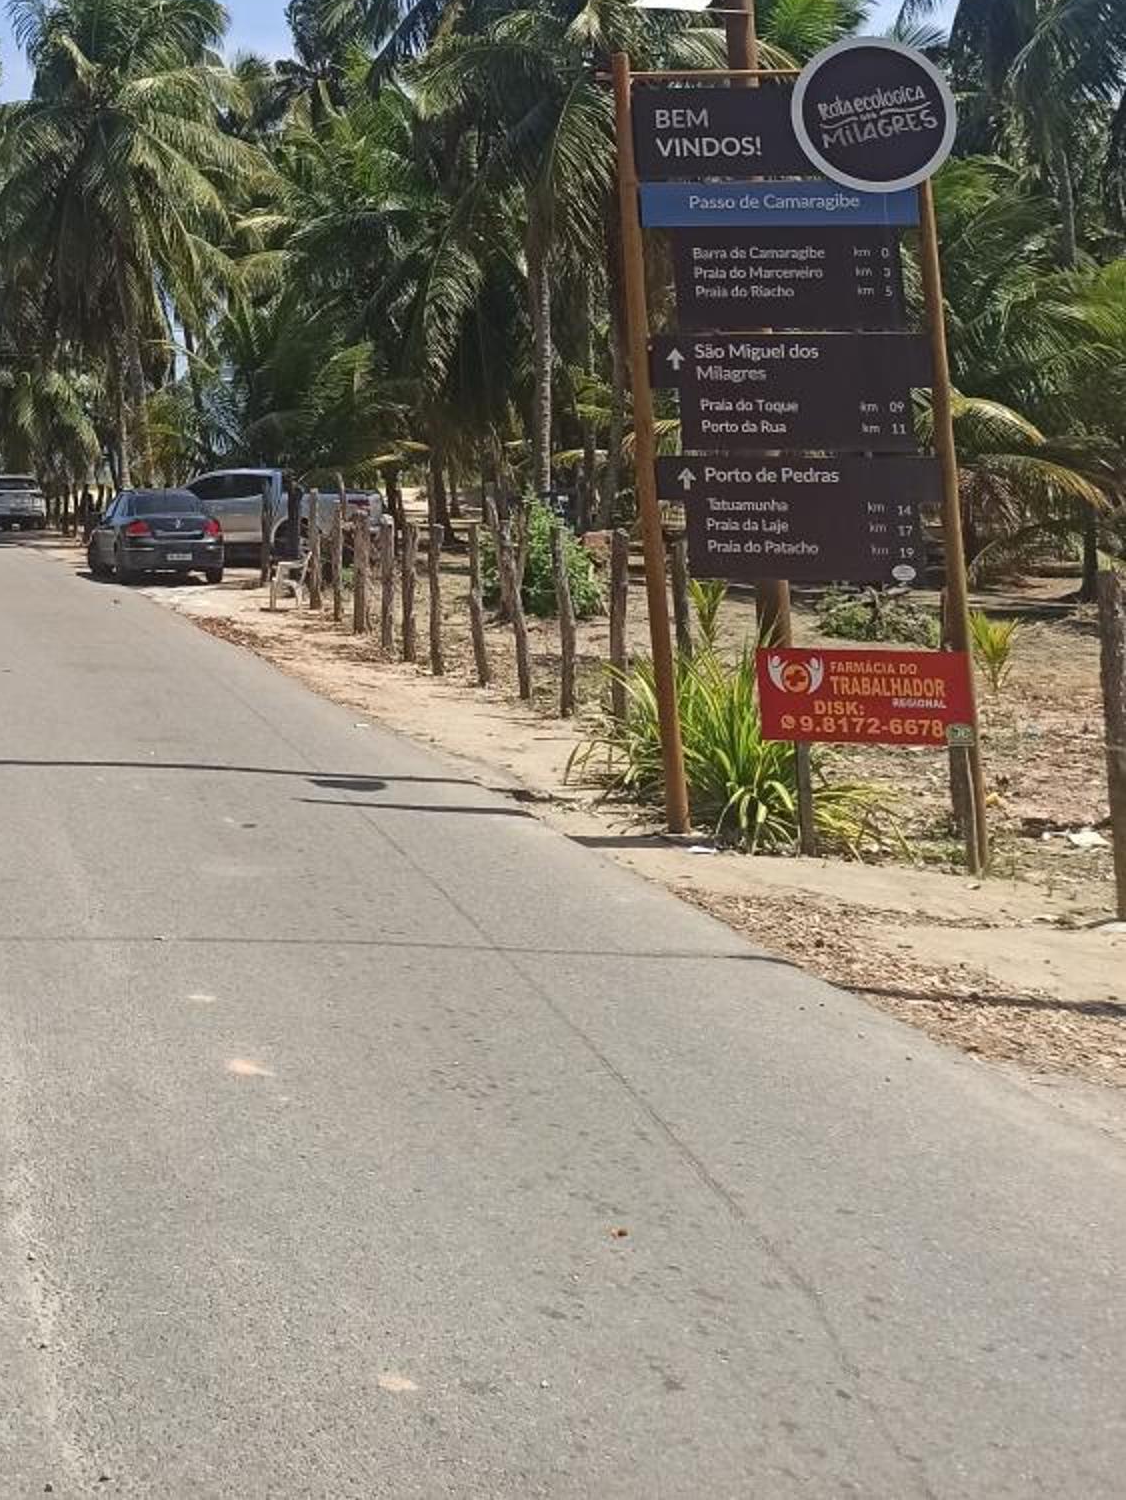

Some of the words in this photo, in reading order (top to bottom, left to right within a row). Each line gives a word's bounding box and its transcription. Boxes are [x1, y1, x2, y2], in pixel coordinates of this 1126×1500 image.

[655, 108, 709, 129] BEM
[656, 136, 762, 157] VINDOS!
[689, 195, 735, 210] Passo
[739, 194, 760, 209] de
[763, 193, 860, 212] Camaragibe
[692, 247, 727, 260] Barra
[729, 247, 746, 259] de
[748, 247, 825, 261] Camaragibe
[853, 246, 871, 258] km
[693, 267, 727, 280] Praia
[730, 267, 746, 279] do
[749, 267, 823, 279] Marceneiro
[855, 266, 873, 277] km
[695, 285, 728, 298] Praia
[731, 285, 748, 298] do
[751, 285, 794, 298] Riacho
[857, 284, 874, 295] km
[885, 286, 892, 297] 5
[694, 344, 724, 360] São
[729, 344, 785, 362] Miguel
[789, 344, 819, 359] dos
[696, 366, 766, 382] Milagres
[700, 398, 732, 412] Praia
[736, 398, 753, 411] do
[758, 399, 798, 415] Toque
[859, 400, 878, 413] km
[889, 401, 905, 413] 09
[701, 420, 738, 433] Porto
[742, 420, 757, 433] da
[761, 420, 786, 433] Rua
[862, 422, 880, 434] km
[892, 423, 907, 435] 11
[704, 467, 751, 484] Porto
[755, 467, 777, 483] de
[781, 467, 840, 484] Pedras
[867, 501, 885, 514] km
[897, 505, 912, 516] 14
[706, 518, 740, 531] Praia
[742, 518, 759, 531] da
[762, 519, 789, 534] Laje
[869, 522, 887, 533] km
[898, 525, 913, 537] 17
[707, 539, 742, 553] Praia
[744, 539, 761, 553] do
[765, 540, 819, 555] Patacho
[900, 547, 914, 559] 19
[829, 660, 895, 675] FARMÁCIA
[899, 663, 918, 675] DO
[829, 676, 947, 698] TRABALHADOR
[814, 700, 865, 716] DISK:
[892, 697, 947, 709] REGIONAL
[800, 714, 944, 737] 9.8172-6678
